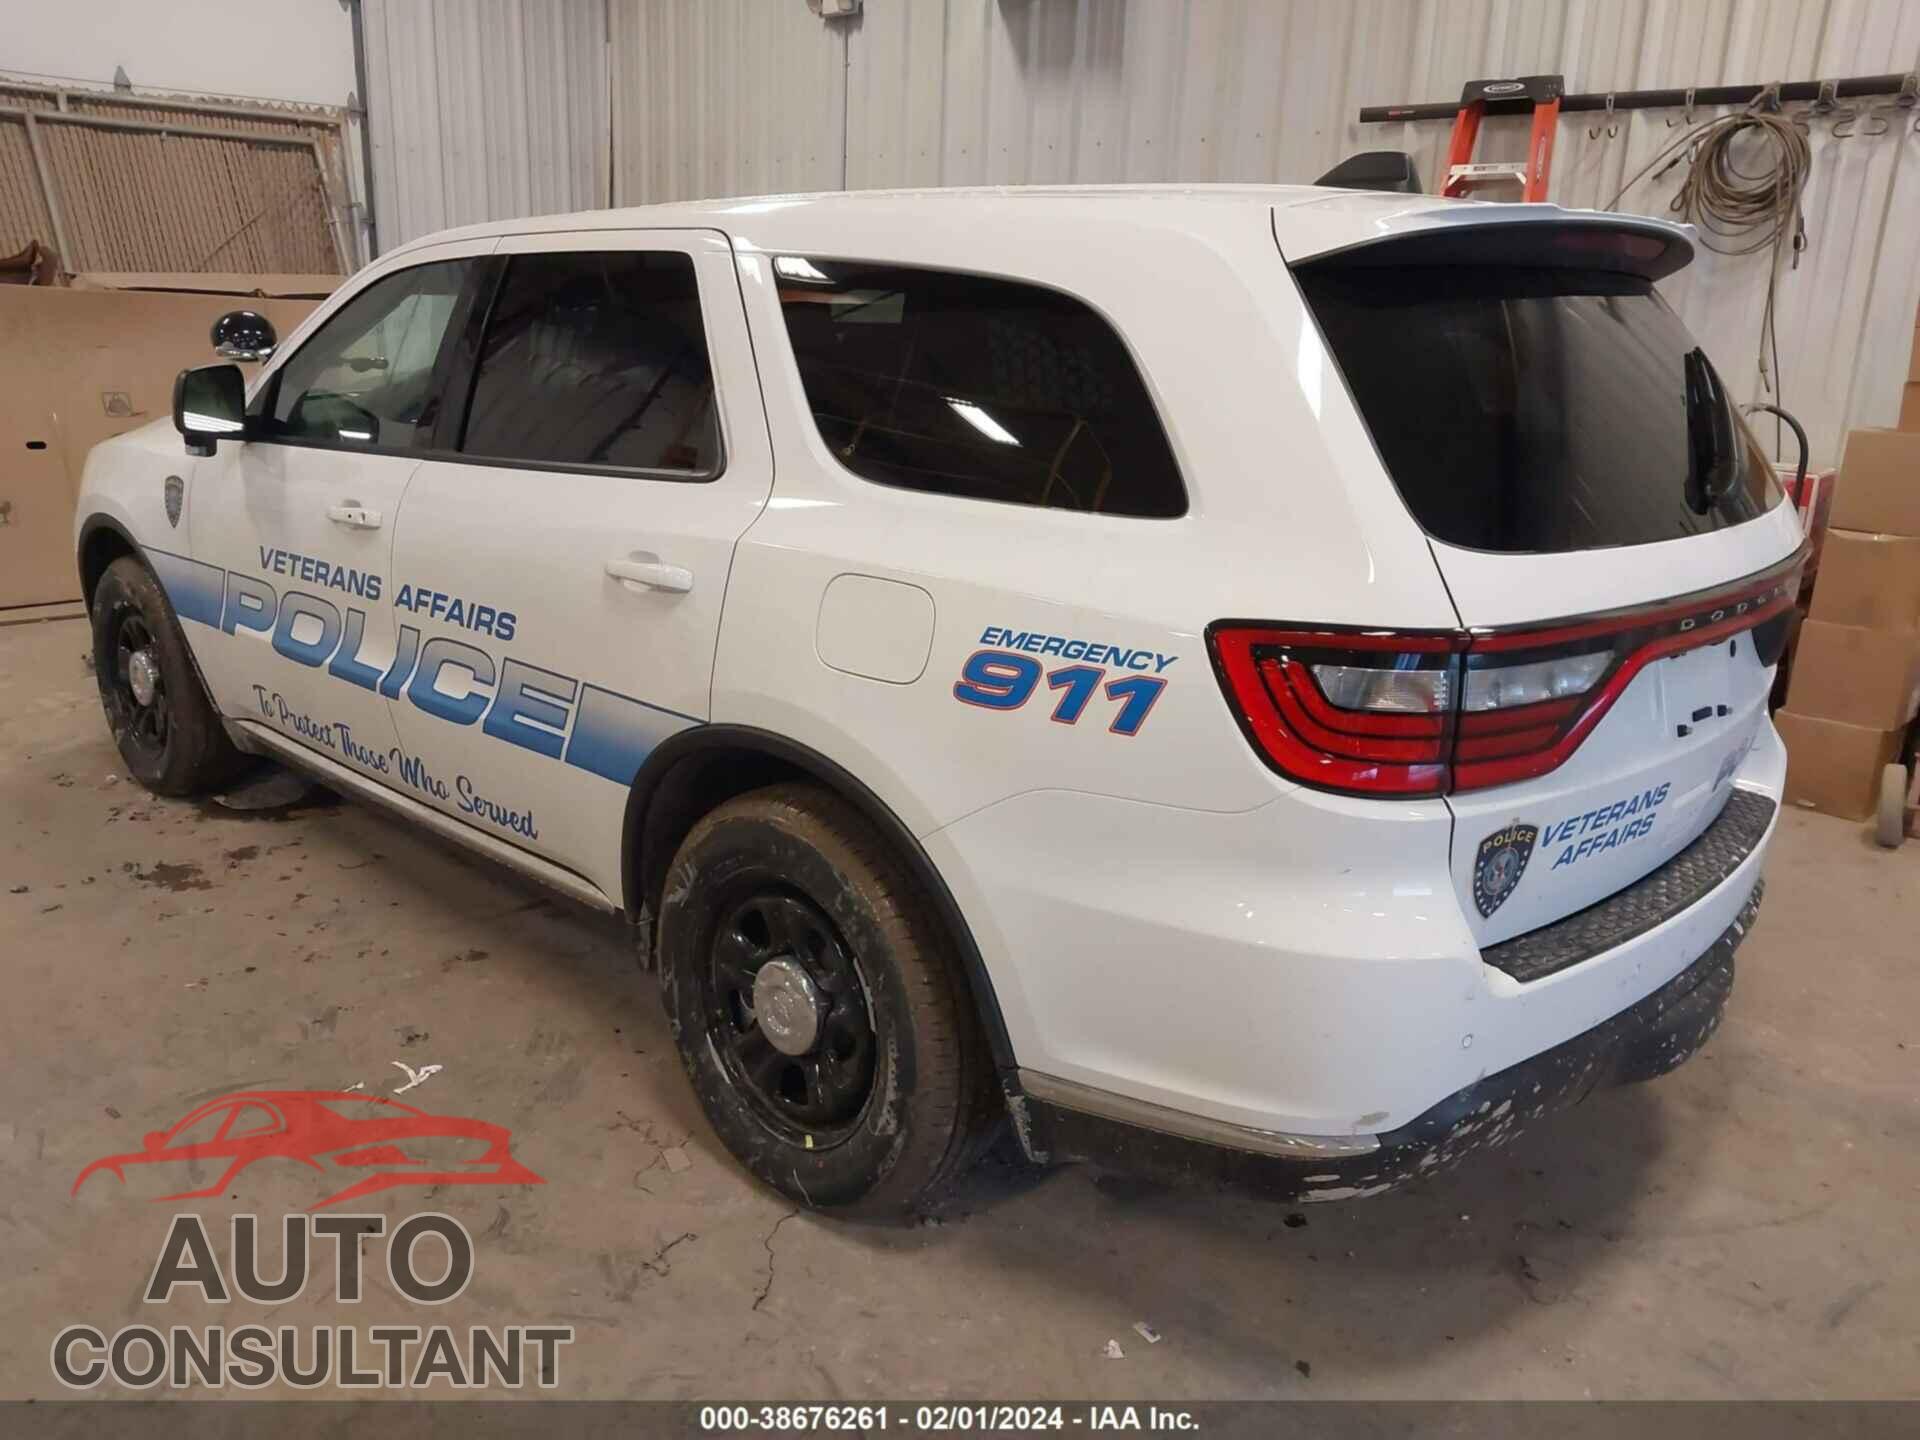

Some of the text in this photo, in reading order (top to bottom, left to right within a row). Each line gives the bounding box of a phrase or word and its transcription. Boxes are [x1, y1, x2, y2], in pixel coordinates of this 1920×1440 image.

[259, 545, 517, 641] VETERANS AFFAIRS
[222, 570, 579, 762] POLICE
[979, 625, 1179, 674] EMERGENCY
[953, 649, 1168, 737] 911
[253, 684, 538, 840] To Protect Those Who Served
[1482, 829, 1535, 855] POLICE
[1540, 781, 1671, 848] VETERANS
[1551, 812, 1656, 871] AFFAIRS
